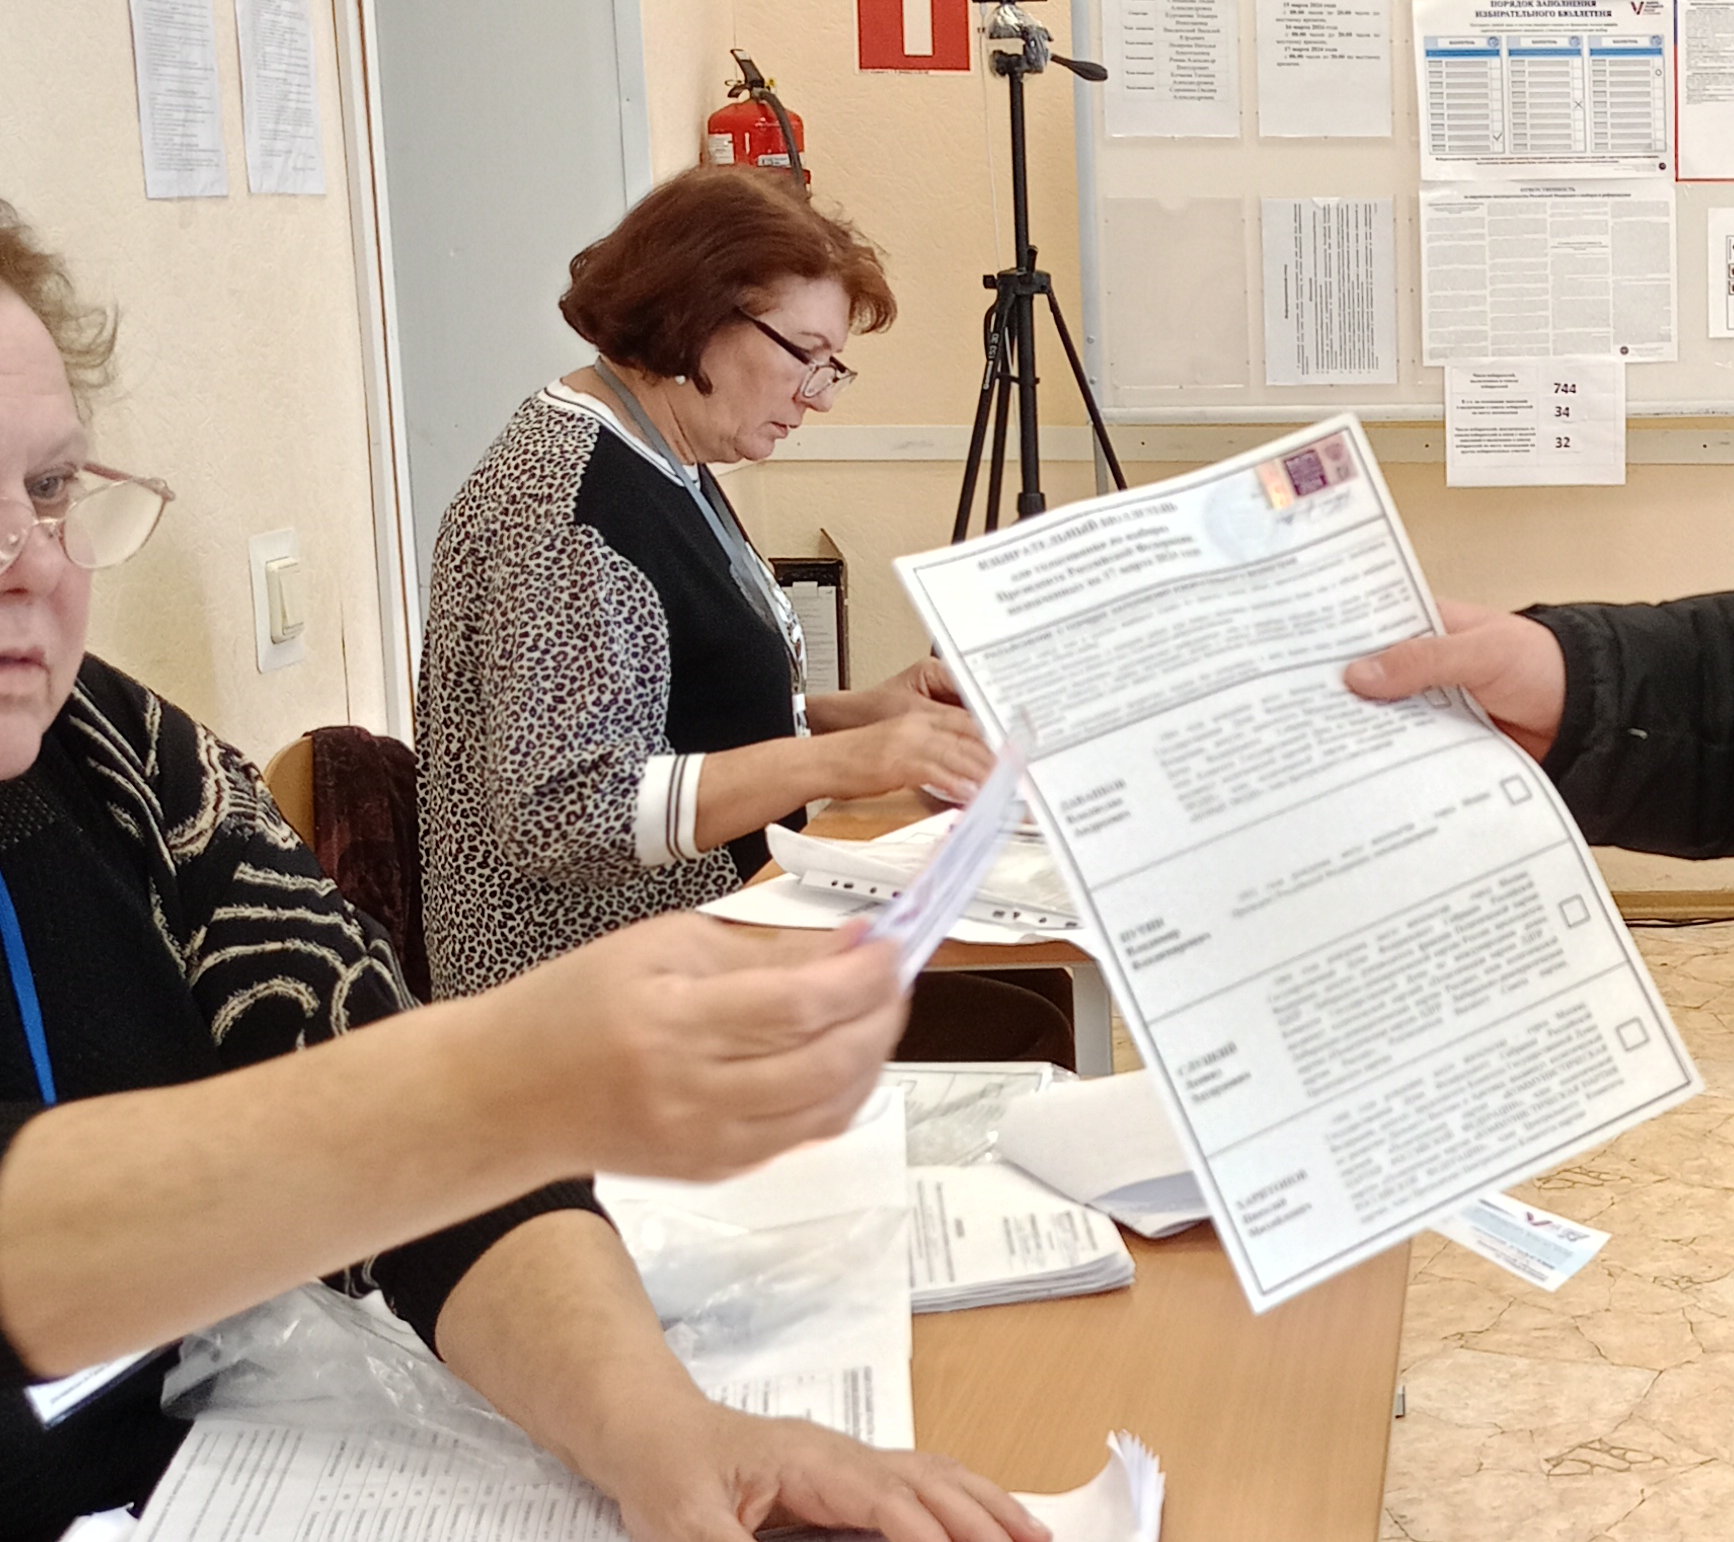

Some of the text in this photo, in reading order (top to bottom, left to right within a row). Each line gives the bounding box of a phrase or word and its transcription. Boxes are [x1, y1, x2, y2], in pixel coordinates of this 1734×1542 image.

[1490, 0, 1597, 8] ПОРЯДОК ЗАПОЛНЕНИЯ
[1475, 9, 1612, 19] ИЗБИРАТЕЛЬНОГО БЮЛЛЕТЕНЯ
[1554, 383, 1577, 394] 744
[1554, 406, 1570, 417] 34
[1555, 437, 1571, 448] 32
